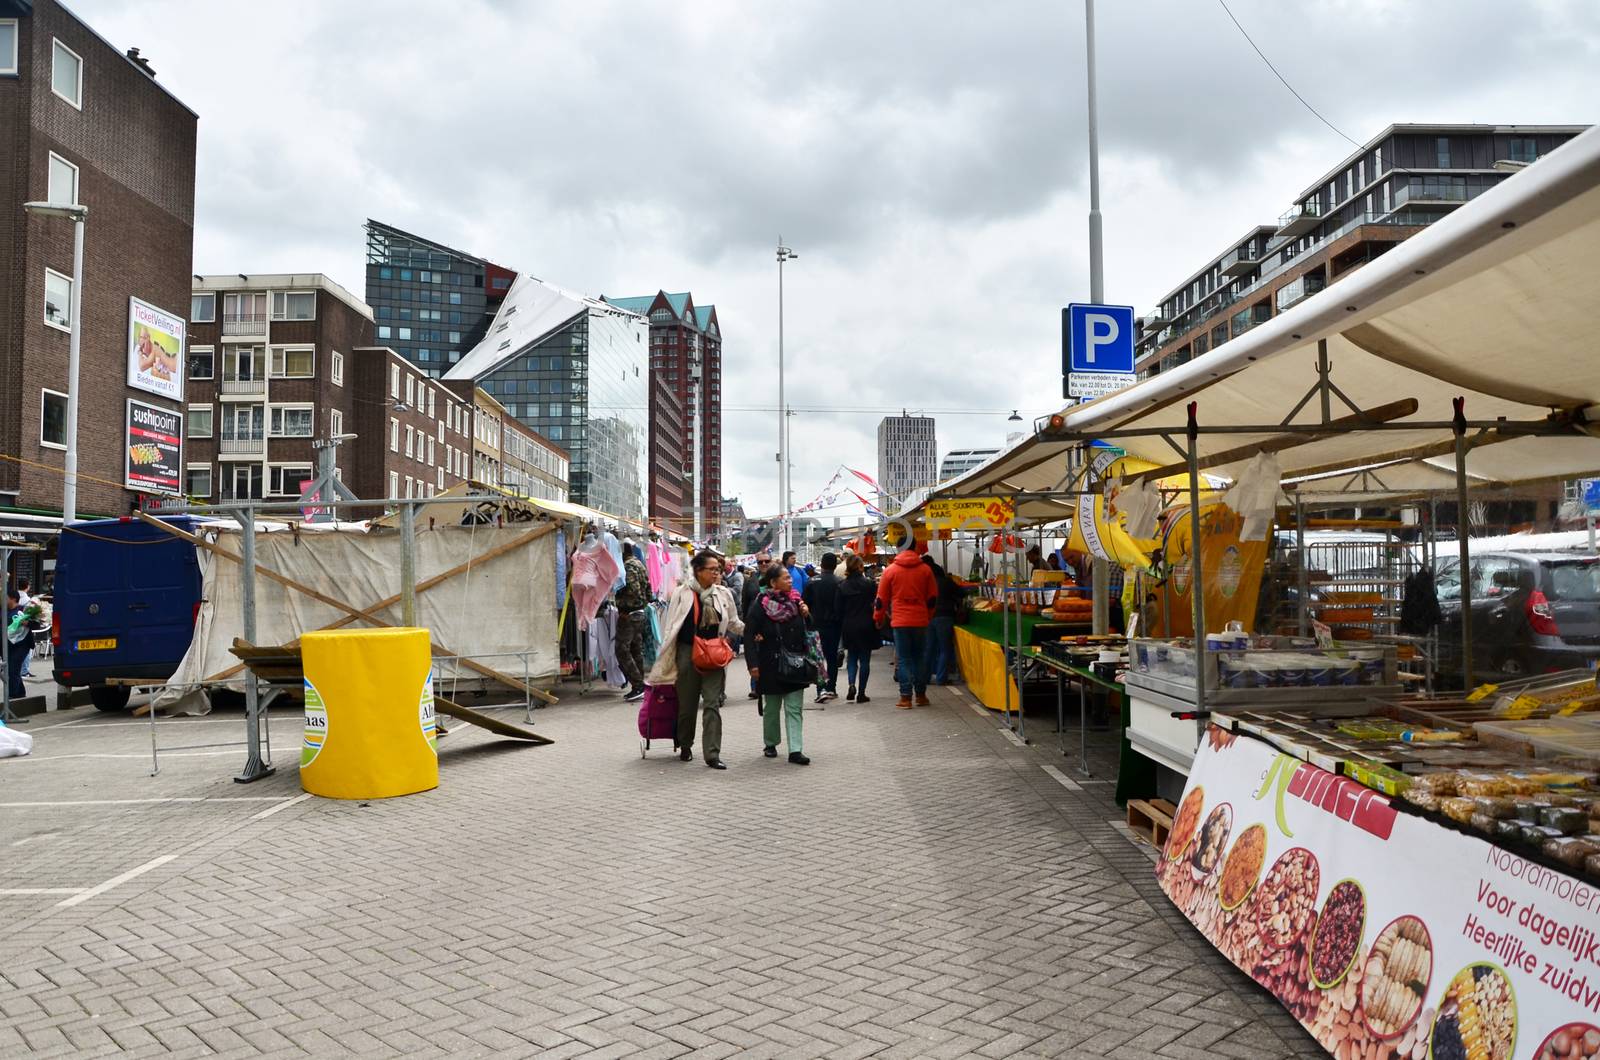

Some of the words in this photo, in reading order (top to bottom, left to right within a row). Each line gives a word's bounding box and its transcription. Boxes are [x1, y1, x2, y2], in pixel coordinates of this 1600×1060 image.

[1085, 313, 1119, 363] P
[133, 409, 176, 431] sushipoint
[1477, 878, 1517, 918] Voor
[1462, 913, 1538, 974] Heerlijke
